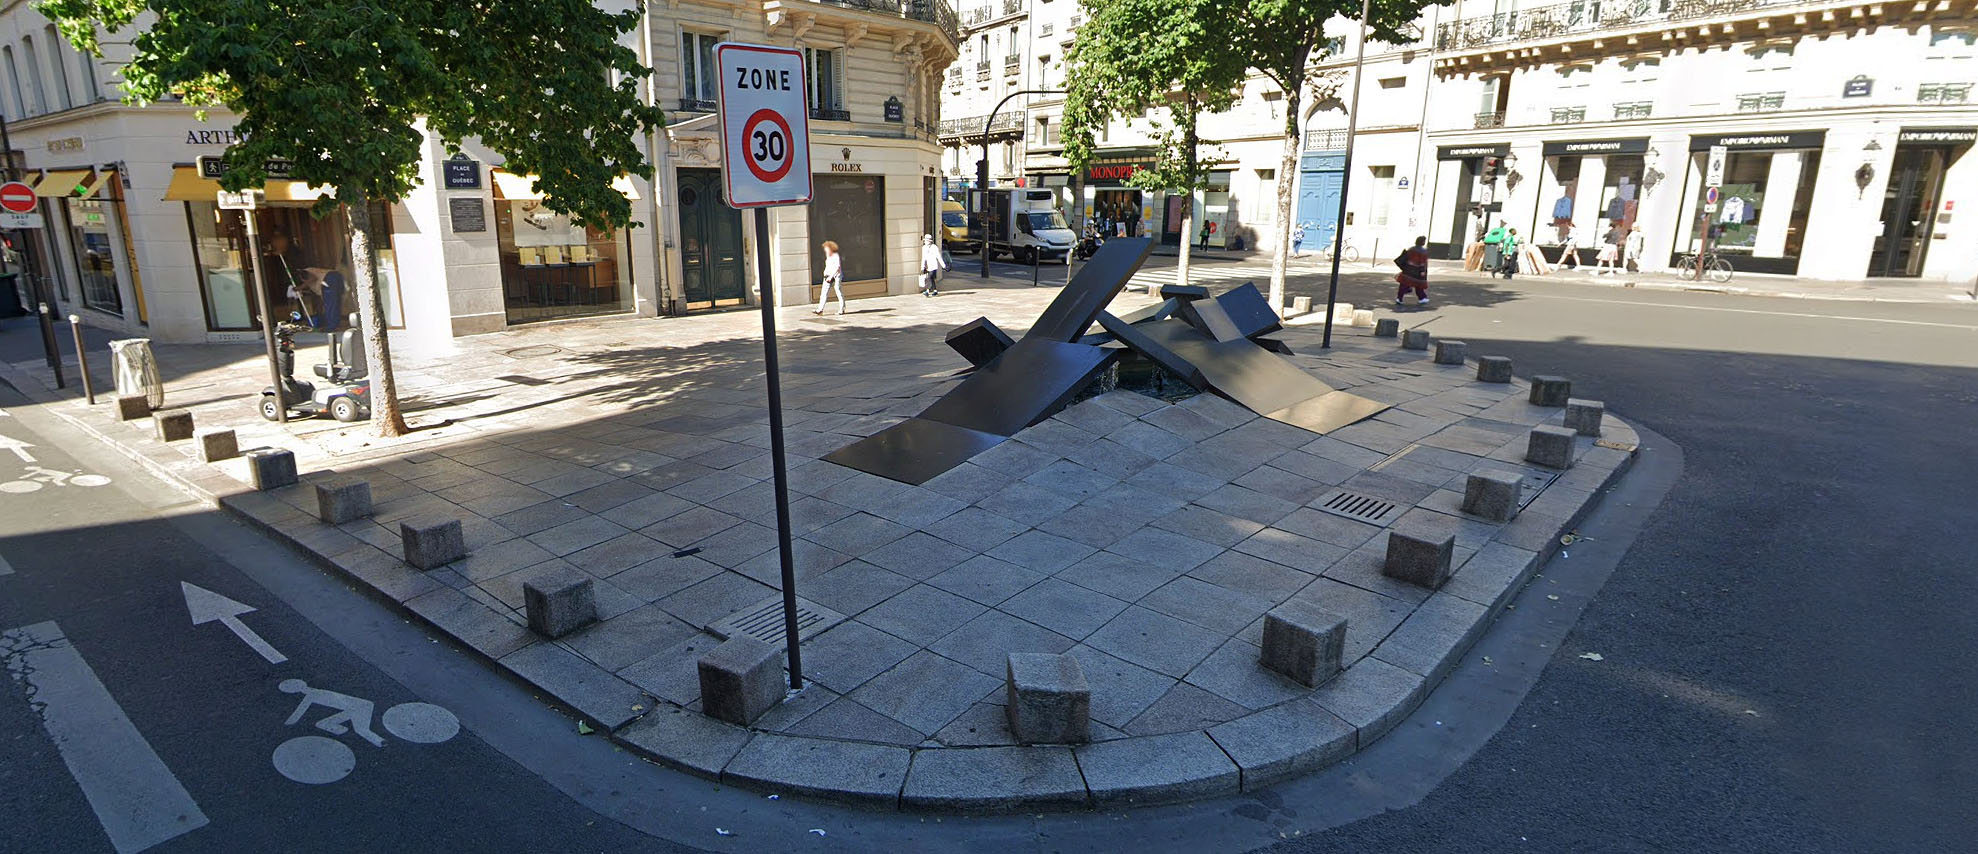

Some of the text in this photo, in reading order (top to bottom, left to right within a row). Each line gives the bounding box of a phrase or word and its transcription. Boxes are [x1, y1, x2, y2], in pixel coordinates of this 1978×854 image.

[736, 67, 791, 92] ZONE
[186, 130, 239, 144] ARTH
[752, 130, 785, 162] 30
[831, 163, 862, 172] ROLEX
[1090, 165, 1146, 179] MONOPR
